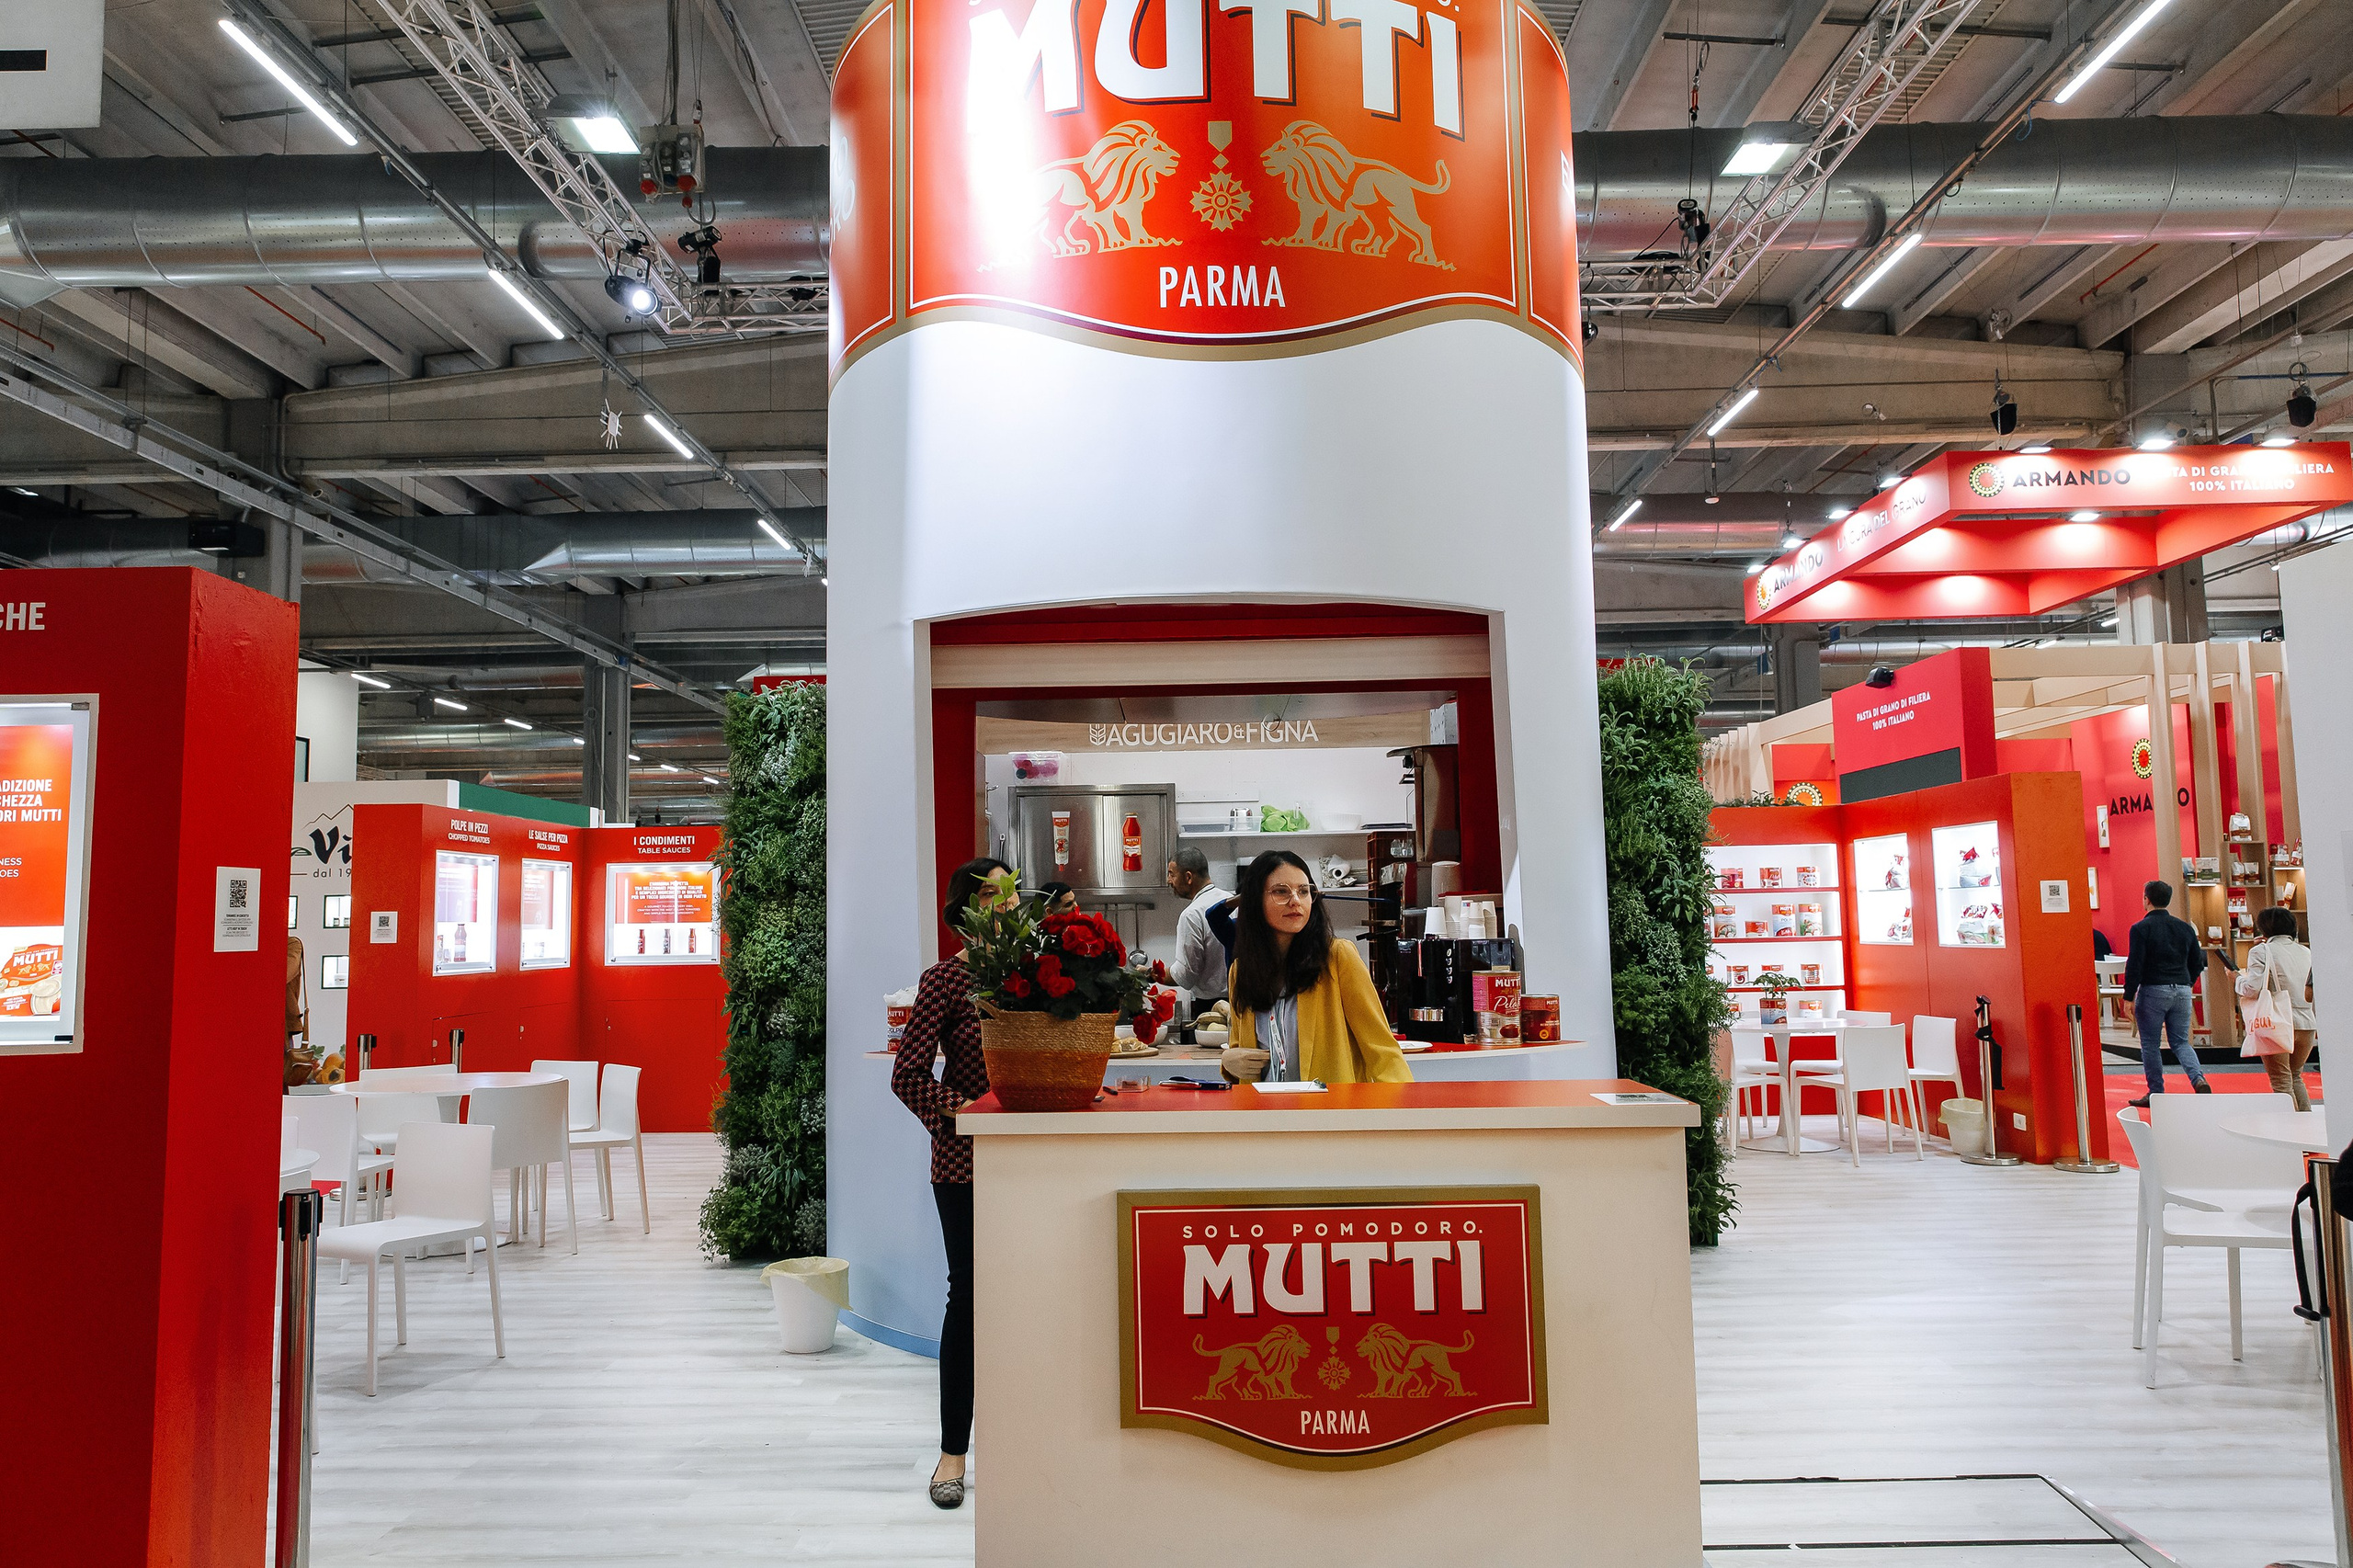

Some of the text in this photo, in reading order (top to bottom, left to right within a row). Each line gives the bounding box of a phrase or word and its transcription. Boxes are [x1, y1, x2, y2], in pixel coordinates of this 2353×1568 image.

[967, 0, 1462, 135] MUTTI
[1159, 265, 1286, 308] PARMA
[2012, 469, 2131, 487] ARMANDO
[2191, 466, 2205, 477] DI
[2189, 478, 2295, 492] 100% ITALIANO
[1872, 509, 1891, 532] DEL
[1773, 551, 1824, 593] ARMANDO
[1856, 691, 1931, 722] PASTA DI GRANO DI FILIERA
[1872, 710, 1915, 731] 100% ITALIANO
[0, 779, 52, 792] DIZIONE
[0, 794, 42, 807] HEZZA
[2109, 788, 2189, 816] ARMAO
[21, 809, 62, 822] MUTTI
[450, 819, 488, 834] POLPE IN PEZZI
[448, 833, 490, 844] CHOPPED TOMATOES
[529, 829, 568, 844] LE SALSE PER PIZZA
[633, 835, 695, 846] I CONDIMENTI
[313, 869, 332, 878] dal
[13, 949, 59, 967] MUTTI
[1182, 1221, 1483, 1239] SOLO POMODORO.
[1183, 1240, 1483, 1315] MUTTI
[1301, 1410, 1370, 1435] PARMA
